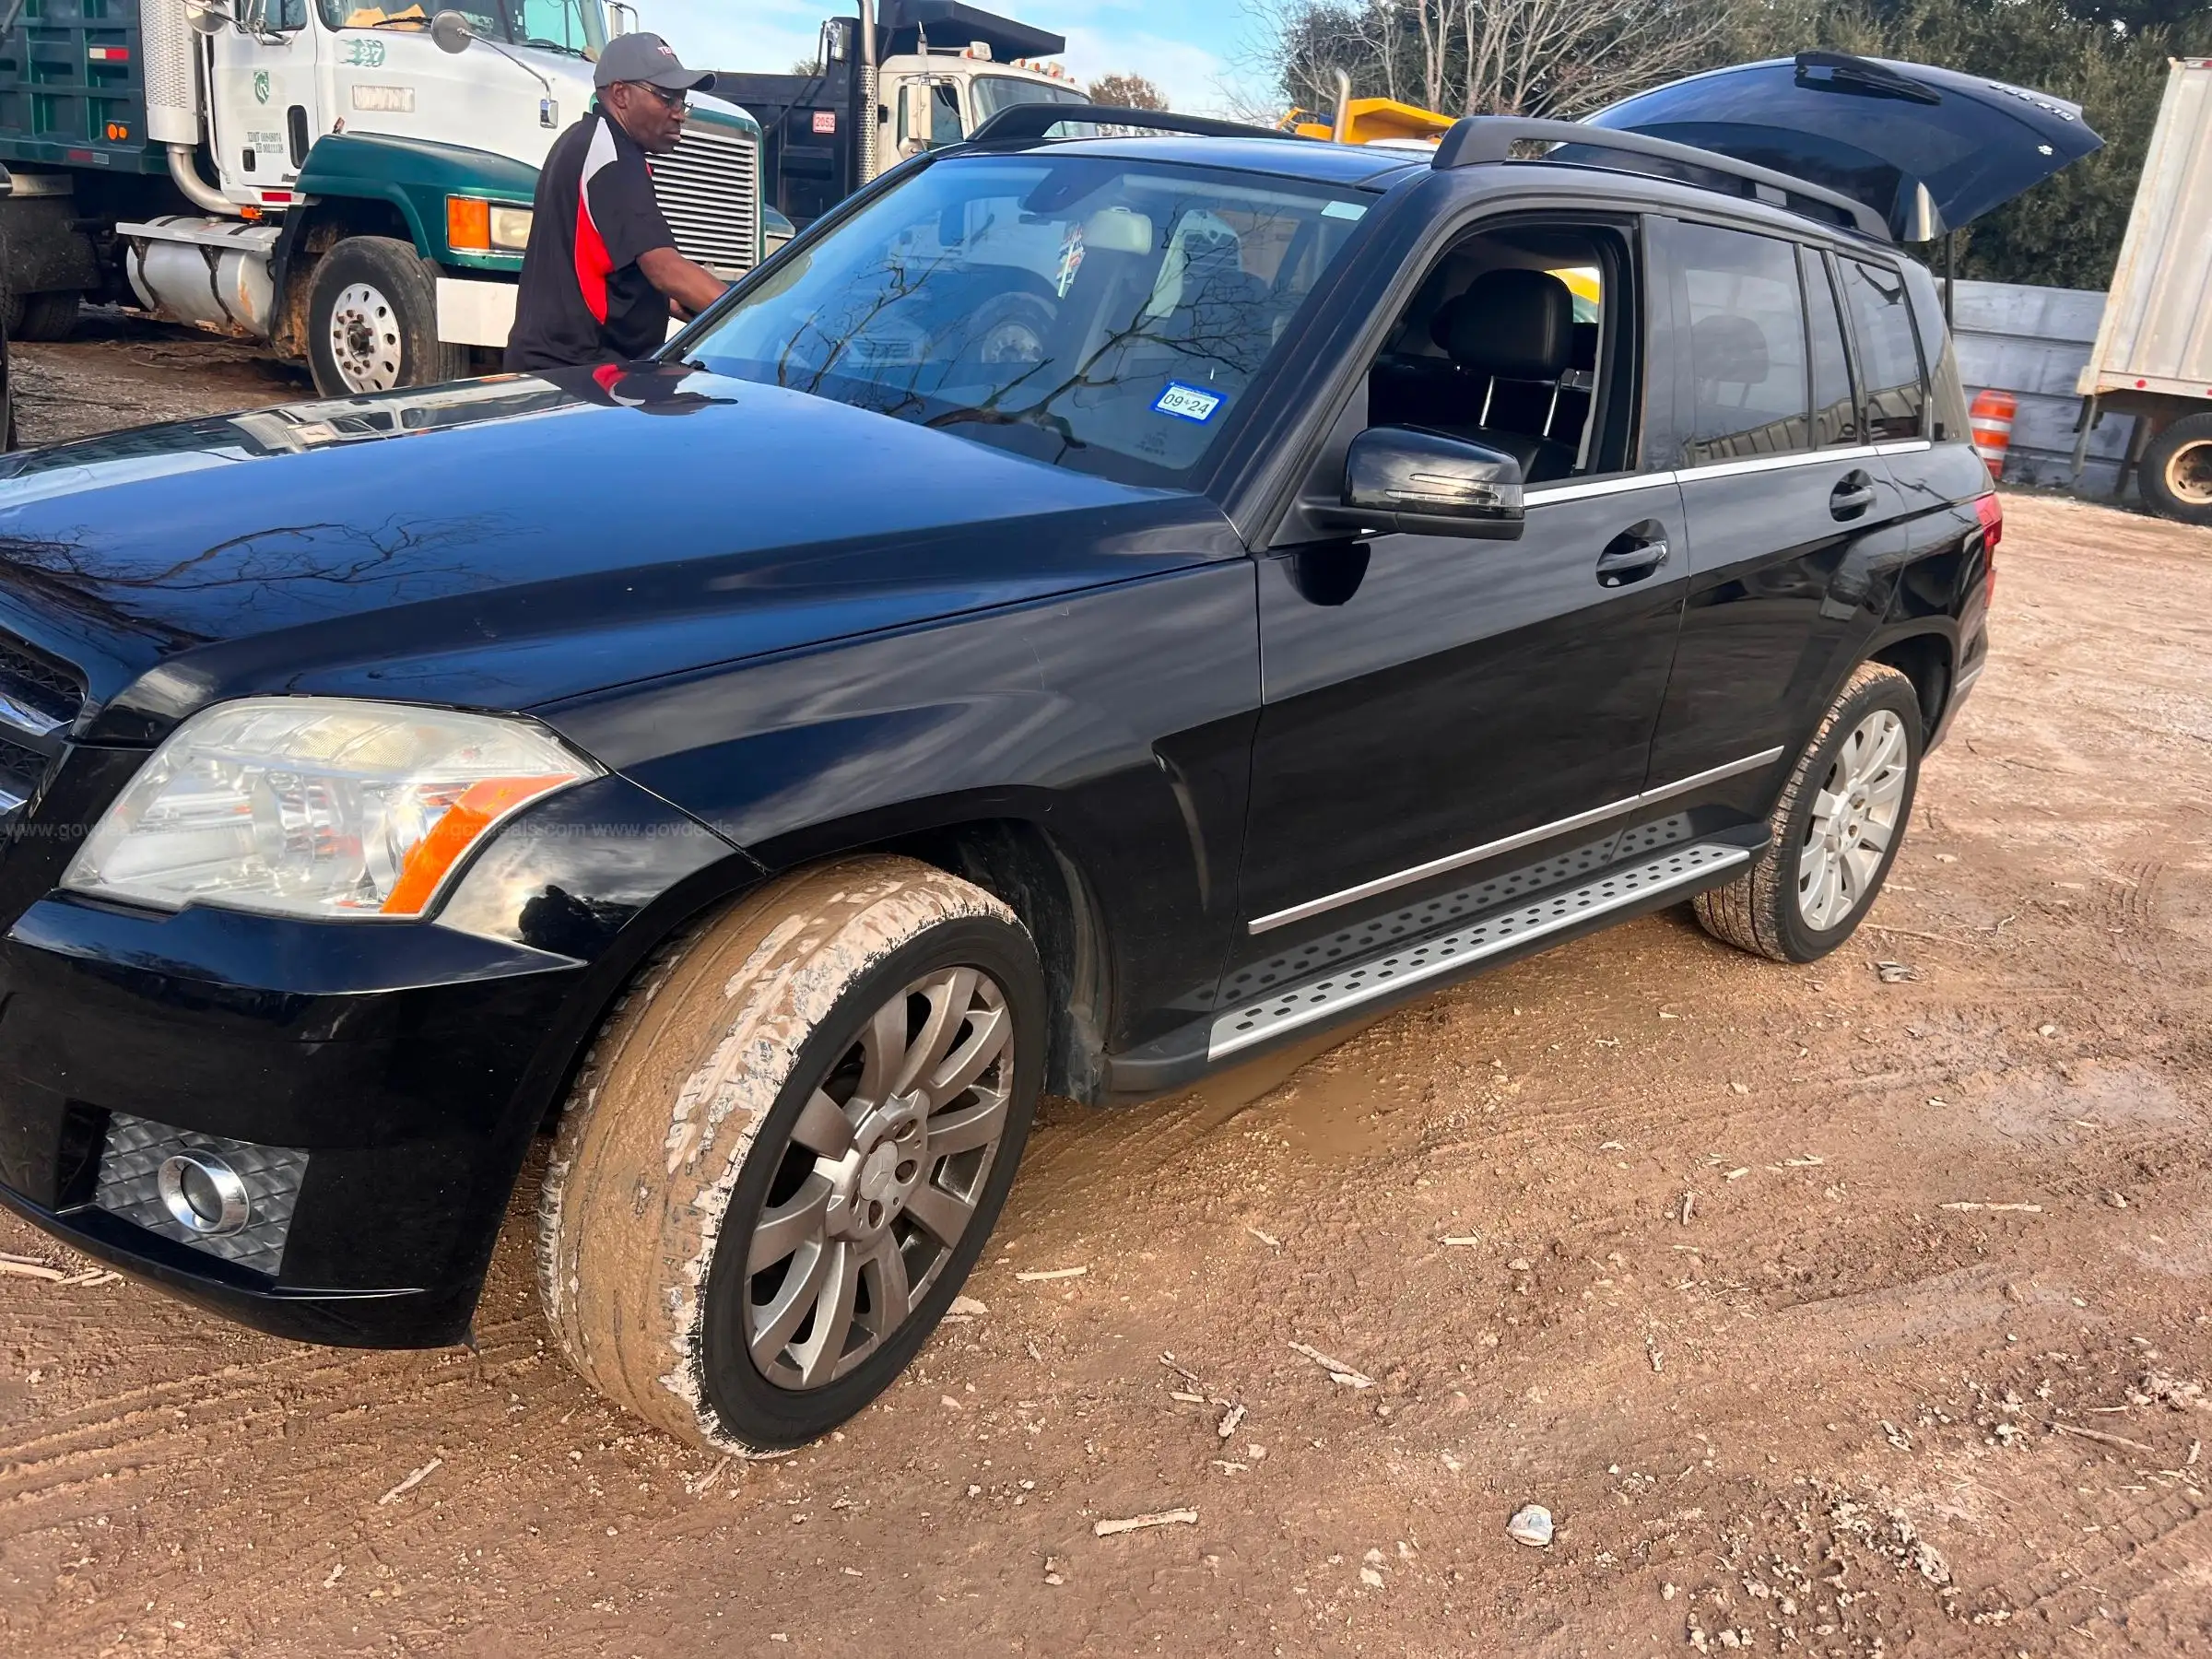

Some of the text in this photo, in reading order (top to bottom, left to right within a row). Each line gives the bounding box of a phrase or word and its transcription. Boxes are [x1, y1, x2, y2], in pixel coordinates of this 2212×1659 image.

[359, 46, 382, 61] 27
[815, 116, 834, 128] 2052
[1163, 394, 1184, 407] 09
[1187, 400, 1210, 414] 24
